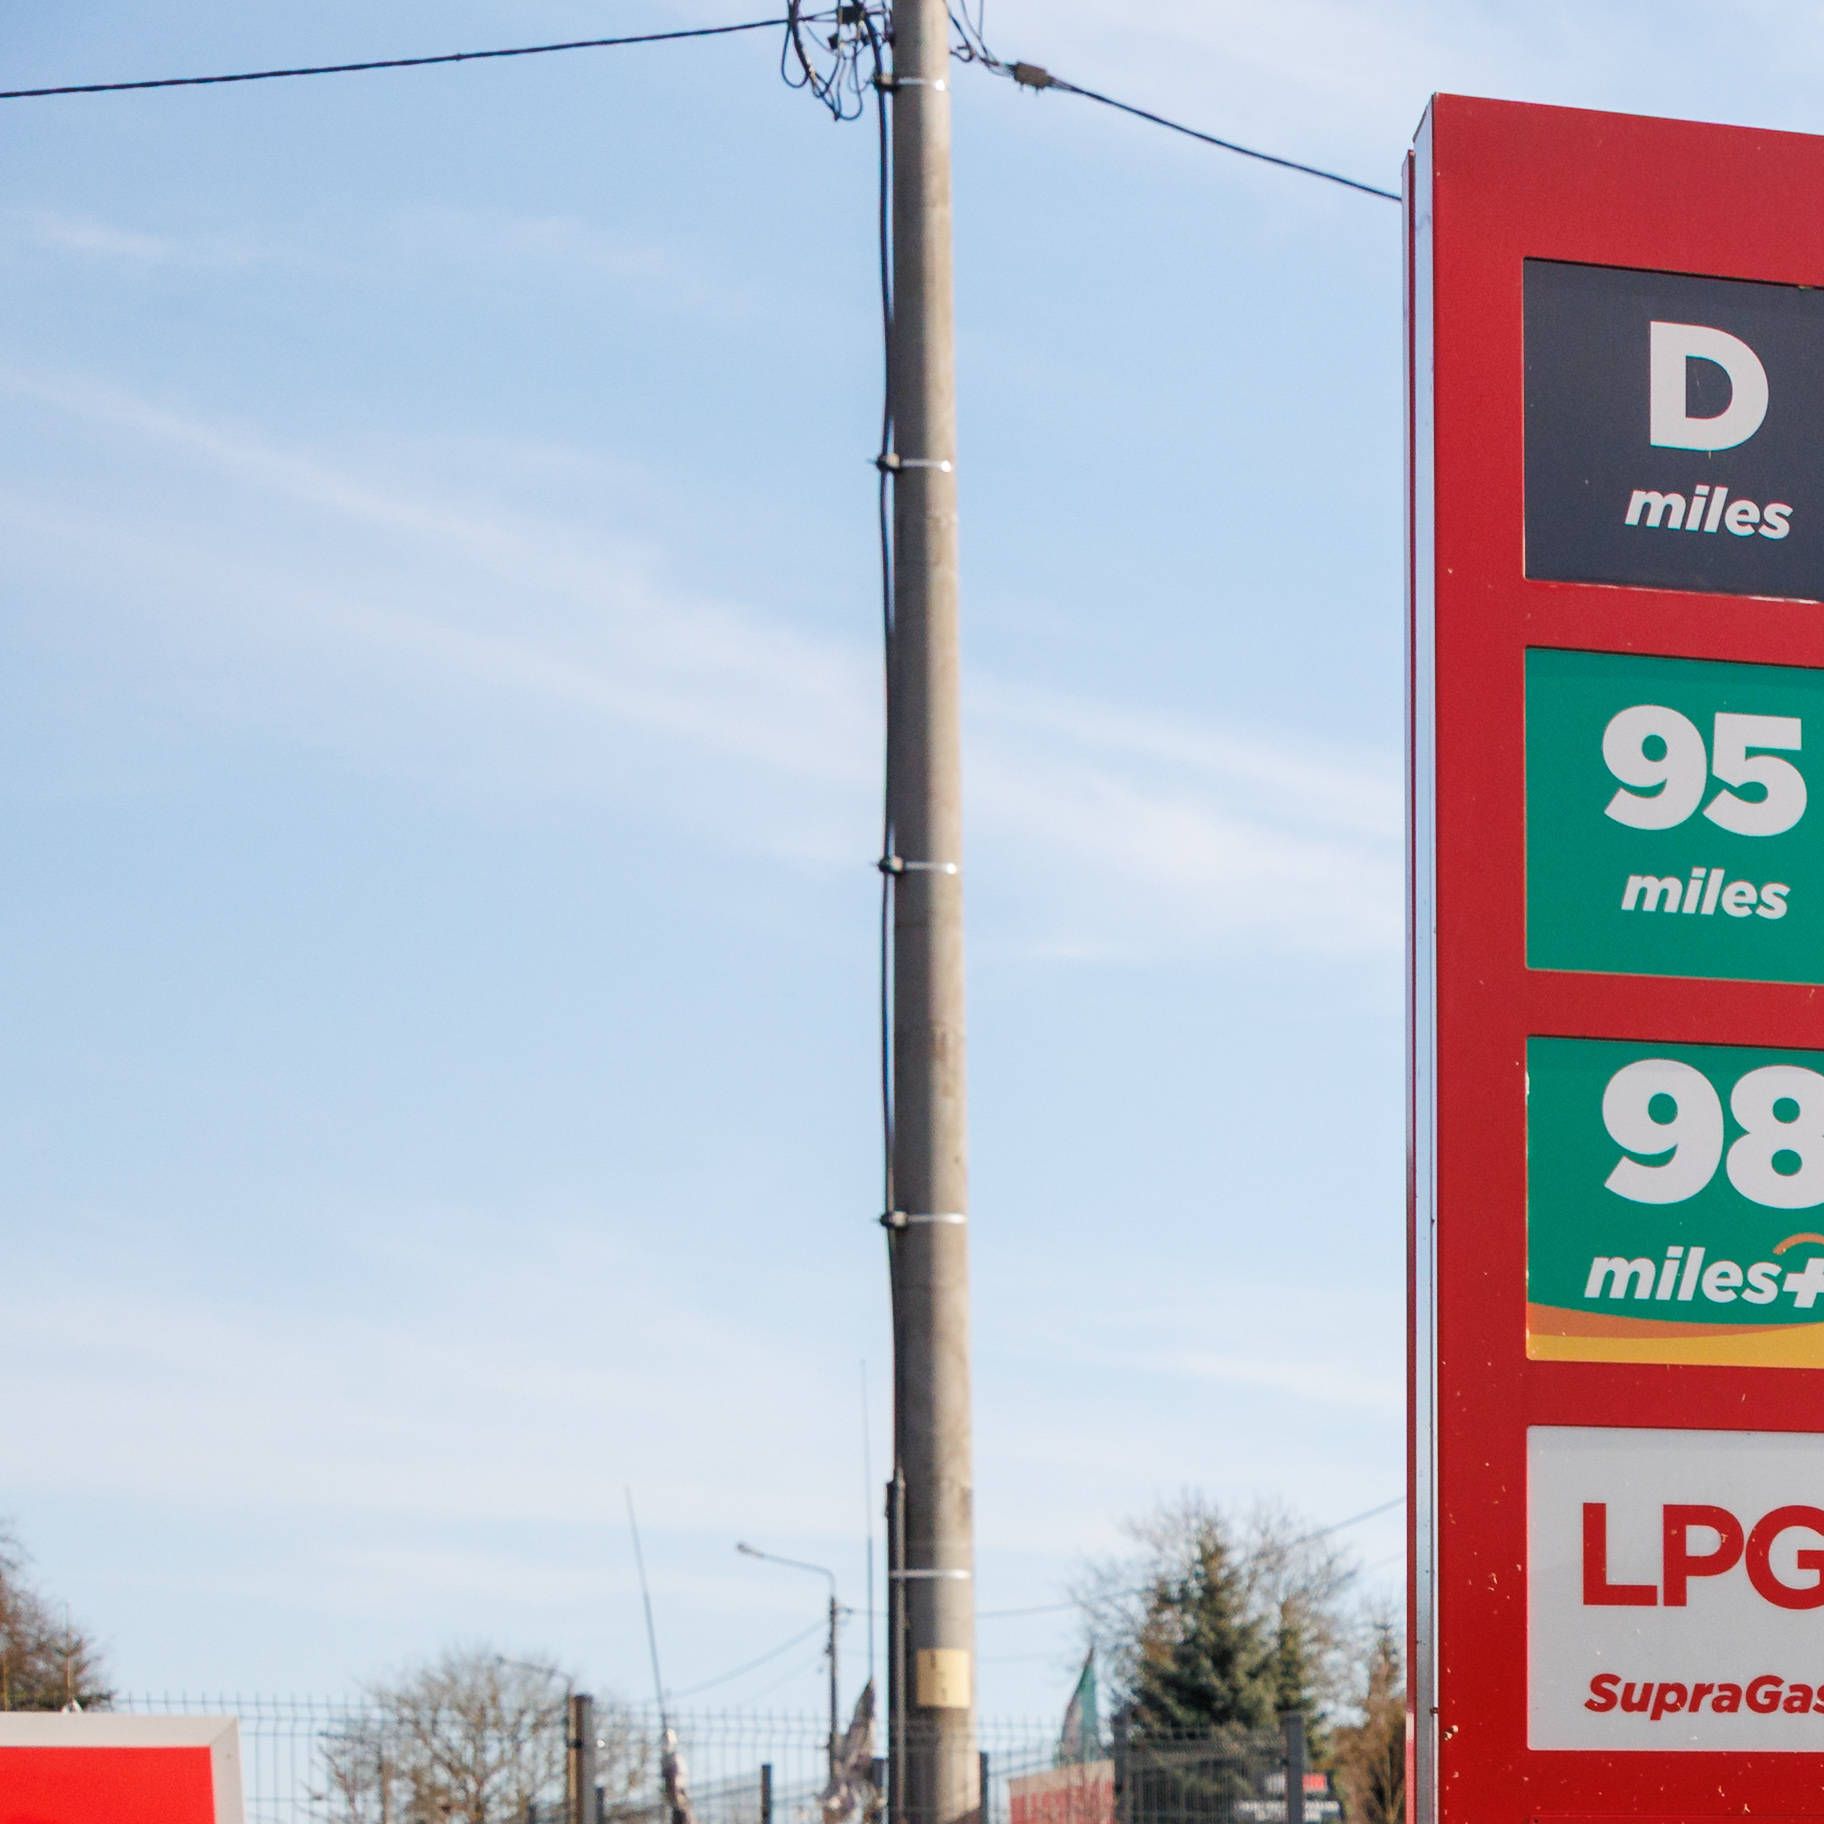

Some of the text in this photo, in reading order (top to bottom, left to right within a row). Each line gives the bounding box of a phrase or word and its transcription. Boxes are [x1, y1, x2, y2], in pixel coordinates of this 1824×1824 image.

[1649, 320, 1770, 452] D
[1624, 485, 1793, 540] miles
[1601, 703, 1808, 837] 95
[1621, 867, 1790, 920] miles
